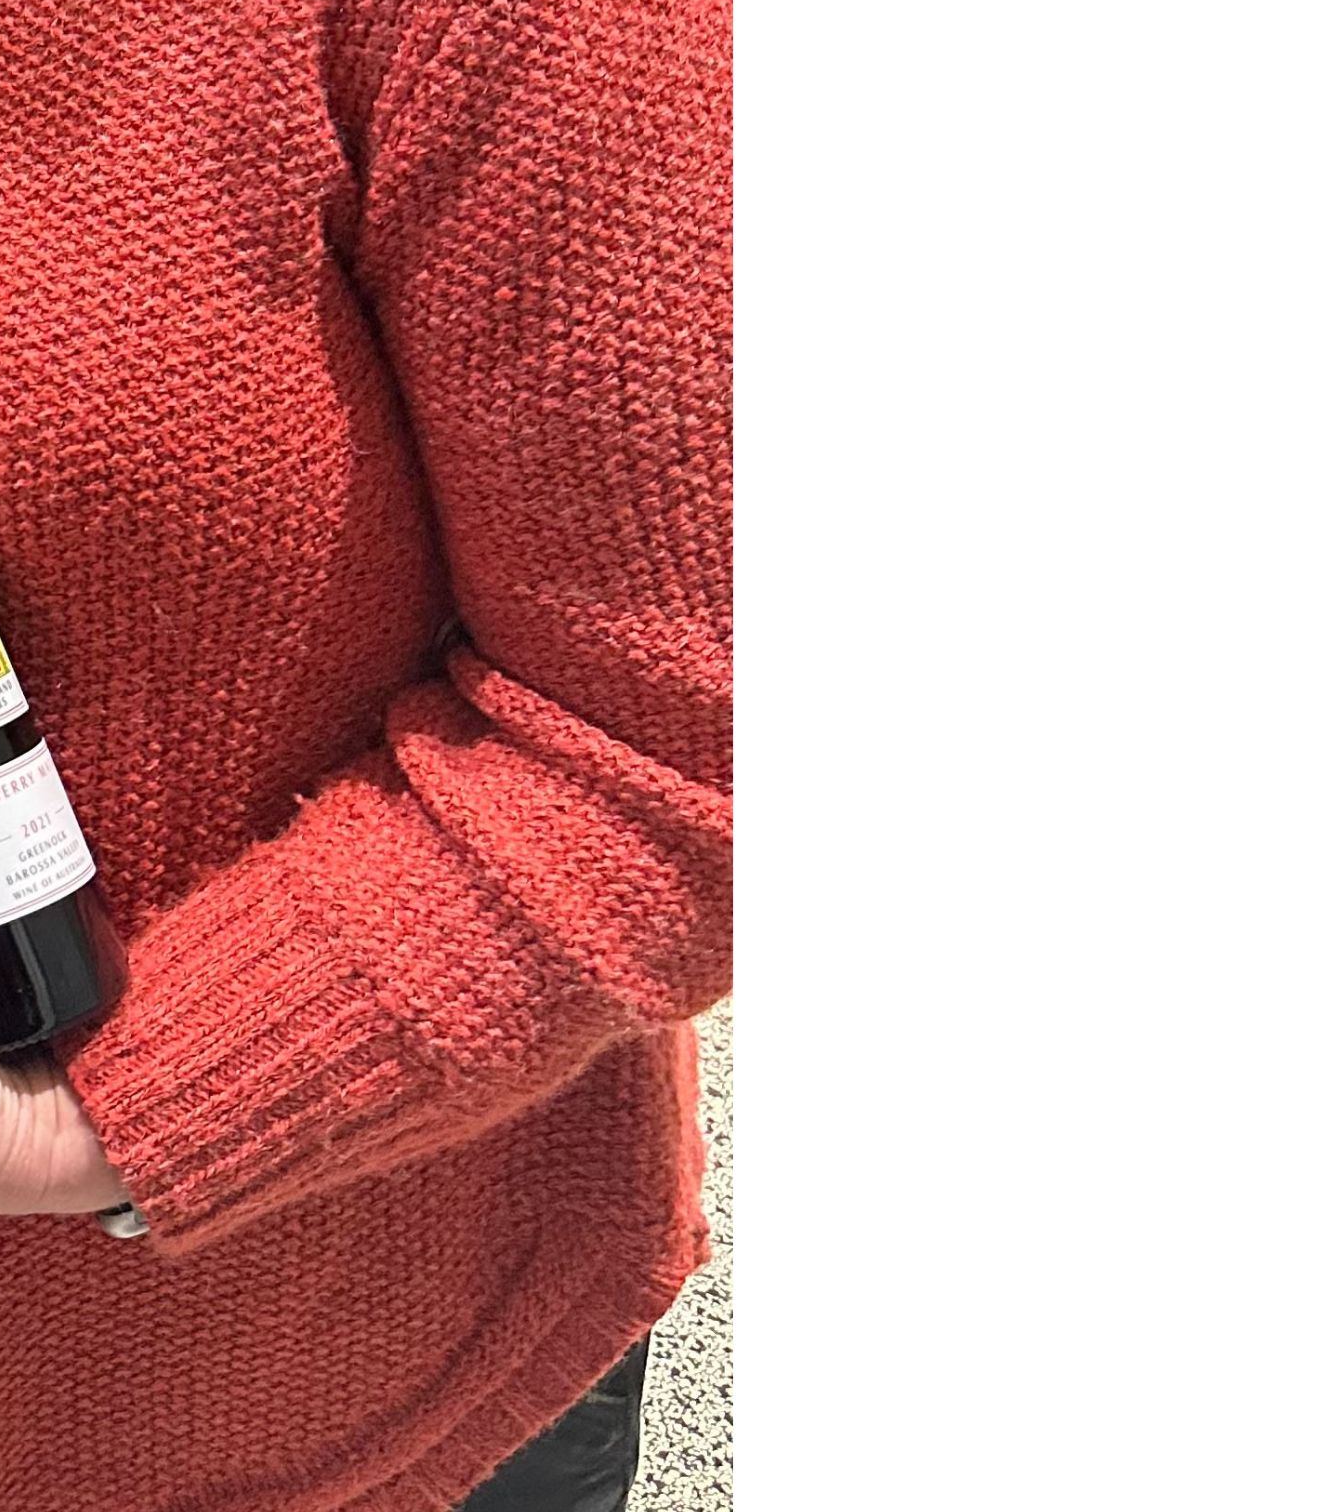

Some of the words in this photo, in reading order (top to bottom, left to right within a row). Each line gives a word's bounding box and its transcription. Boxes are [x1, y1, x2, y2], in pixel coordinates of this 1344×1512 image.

[21, 812, 52, 839] 2021
[18, 830, 67, 863] GREENOCK
[6, 856, 57, 886] BAROSSA
[12, 883, 39, 900] WINE
[41, 877, 53, 888] OF
